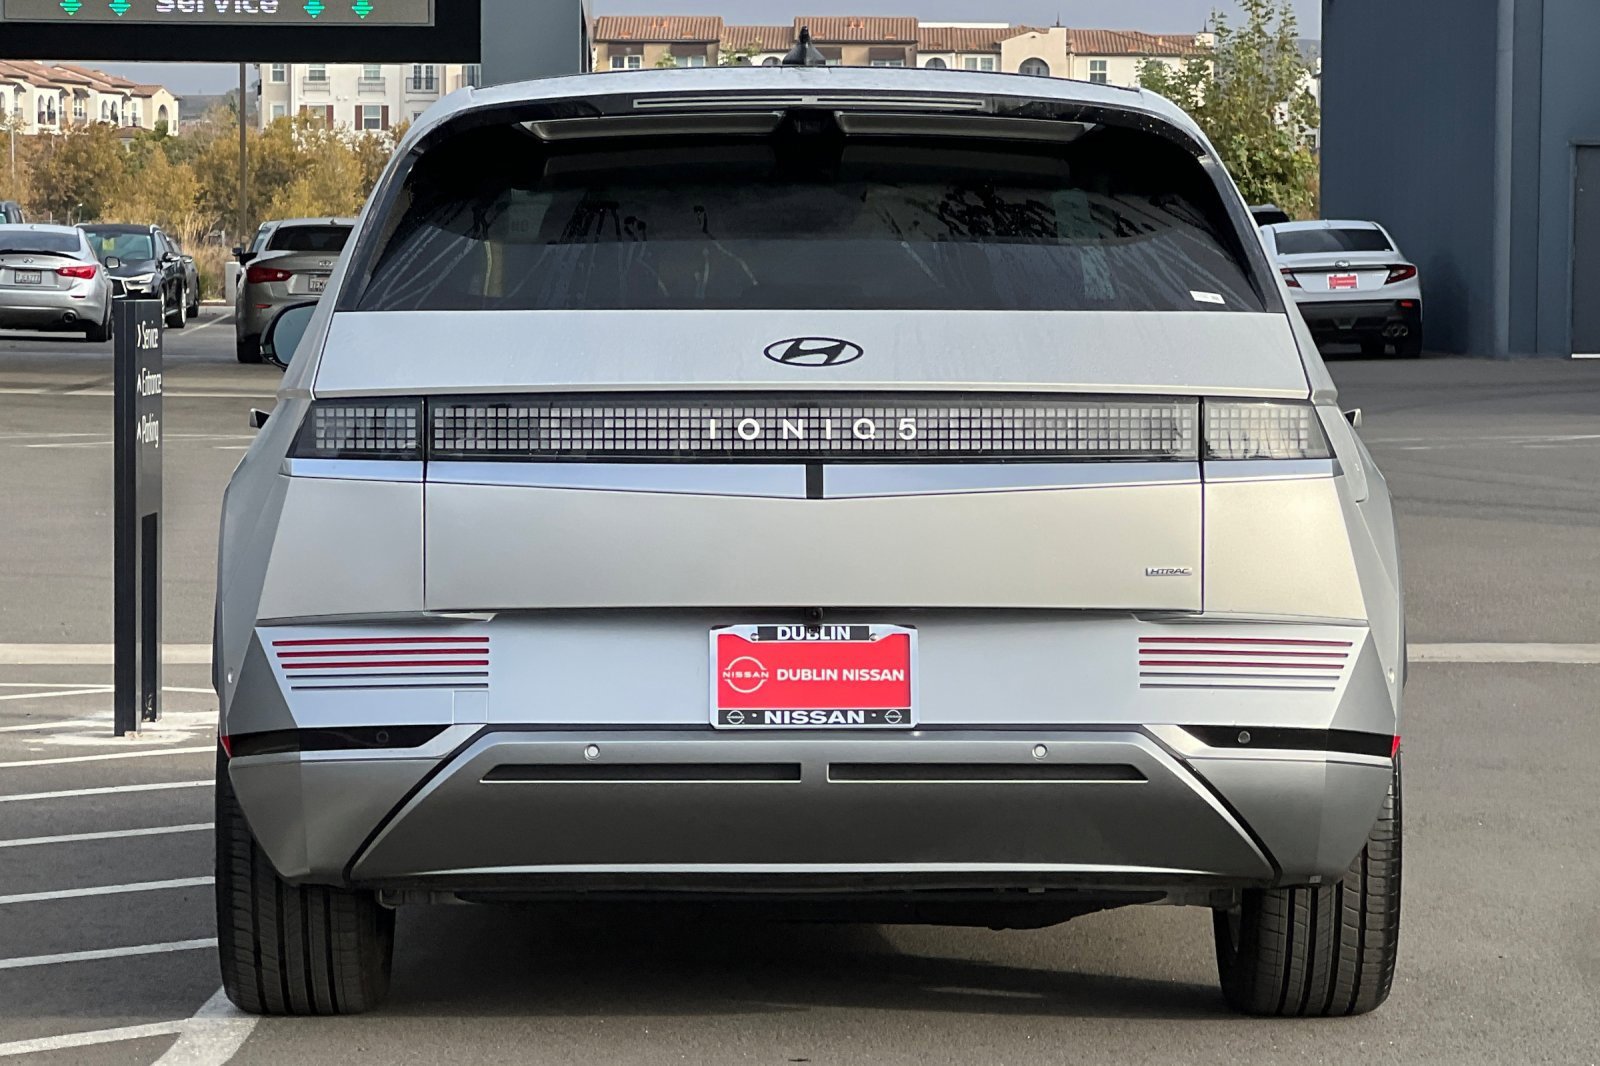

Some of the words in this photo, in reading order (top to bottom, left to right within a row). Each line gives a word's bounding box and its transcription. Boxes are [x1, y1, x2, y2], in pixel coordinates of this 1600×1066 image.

[142, 320, 159, 349] Service
[142, 367, 161, 397] Entrance
[142, 413, 159, 448] Parking
[709, 418, 876, 440] IONIQ
[898, 418, 917, 440] 5
[1148, 567, 1191, 576] HTRAC
[777, 626, 851, 640] DUBLIN
[722, 671, 769, 679] NISSAN
[776, 668, 838, 681] DUBLIN
[842, 668, 904, 681] NISSAN
[764, 710, 865, 724] NISSAN
